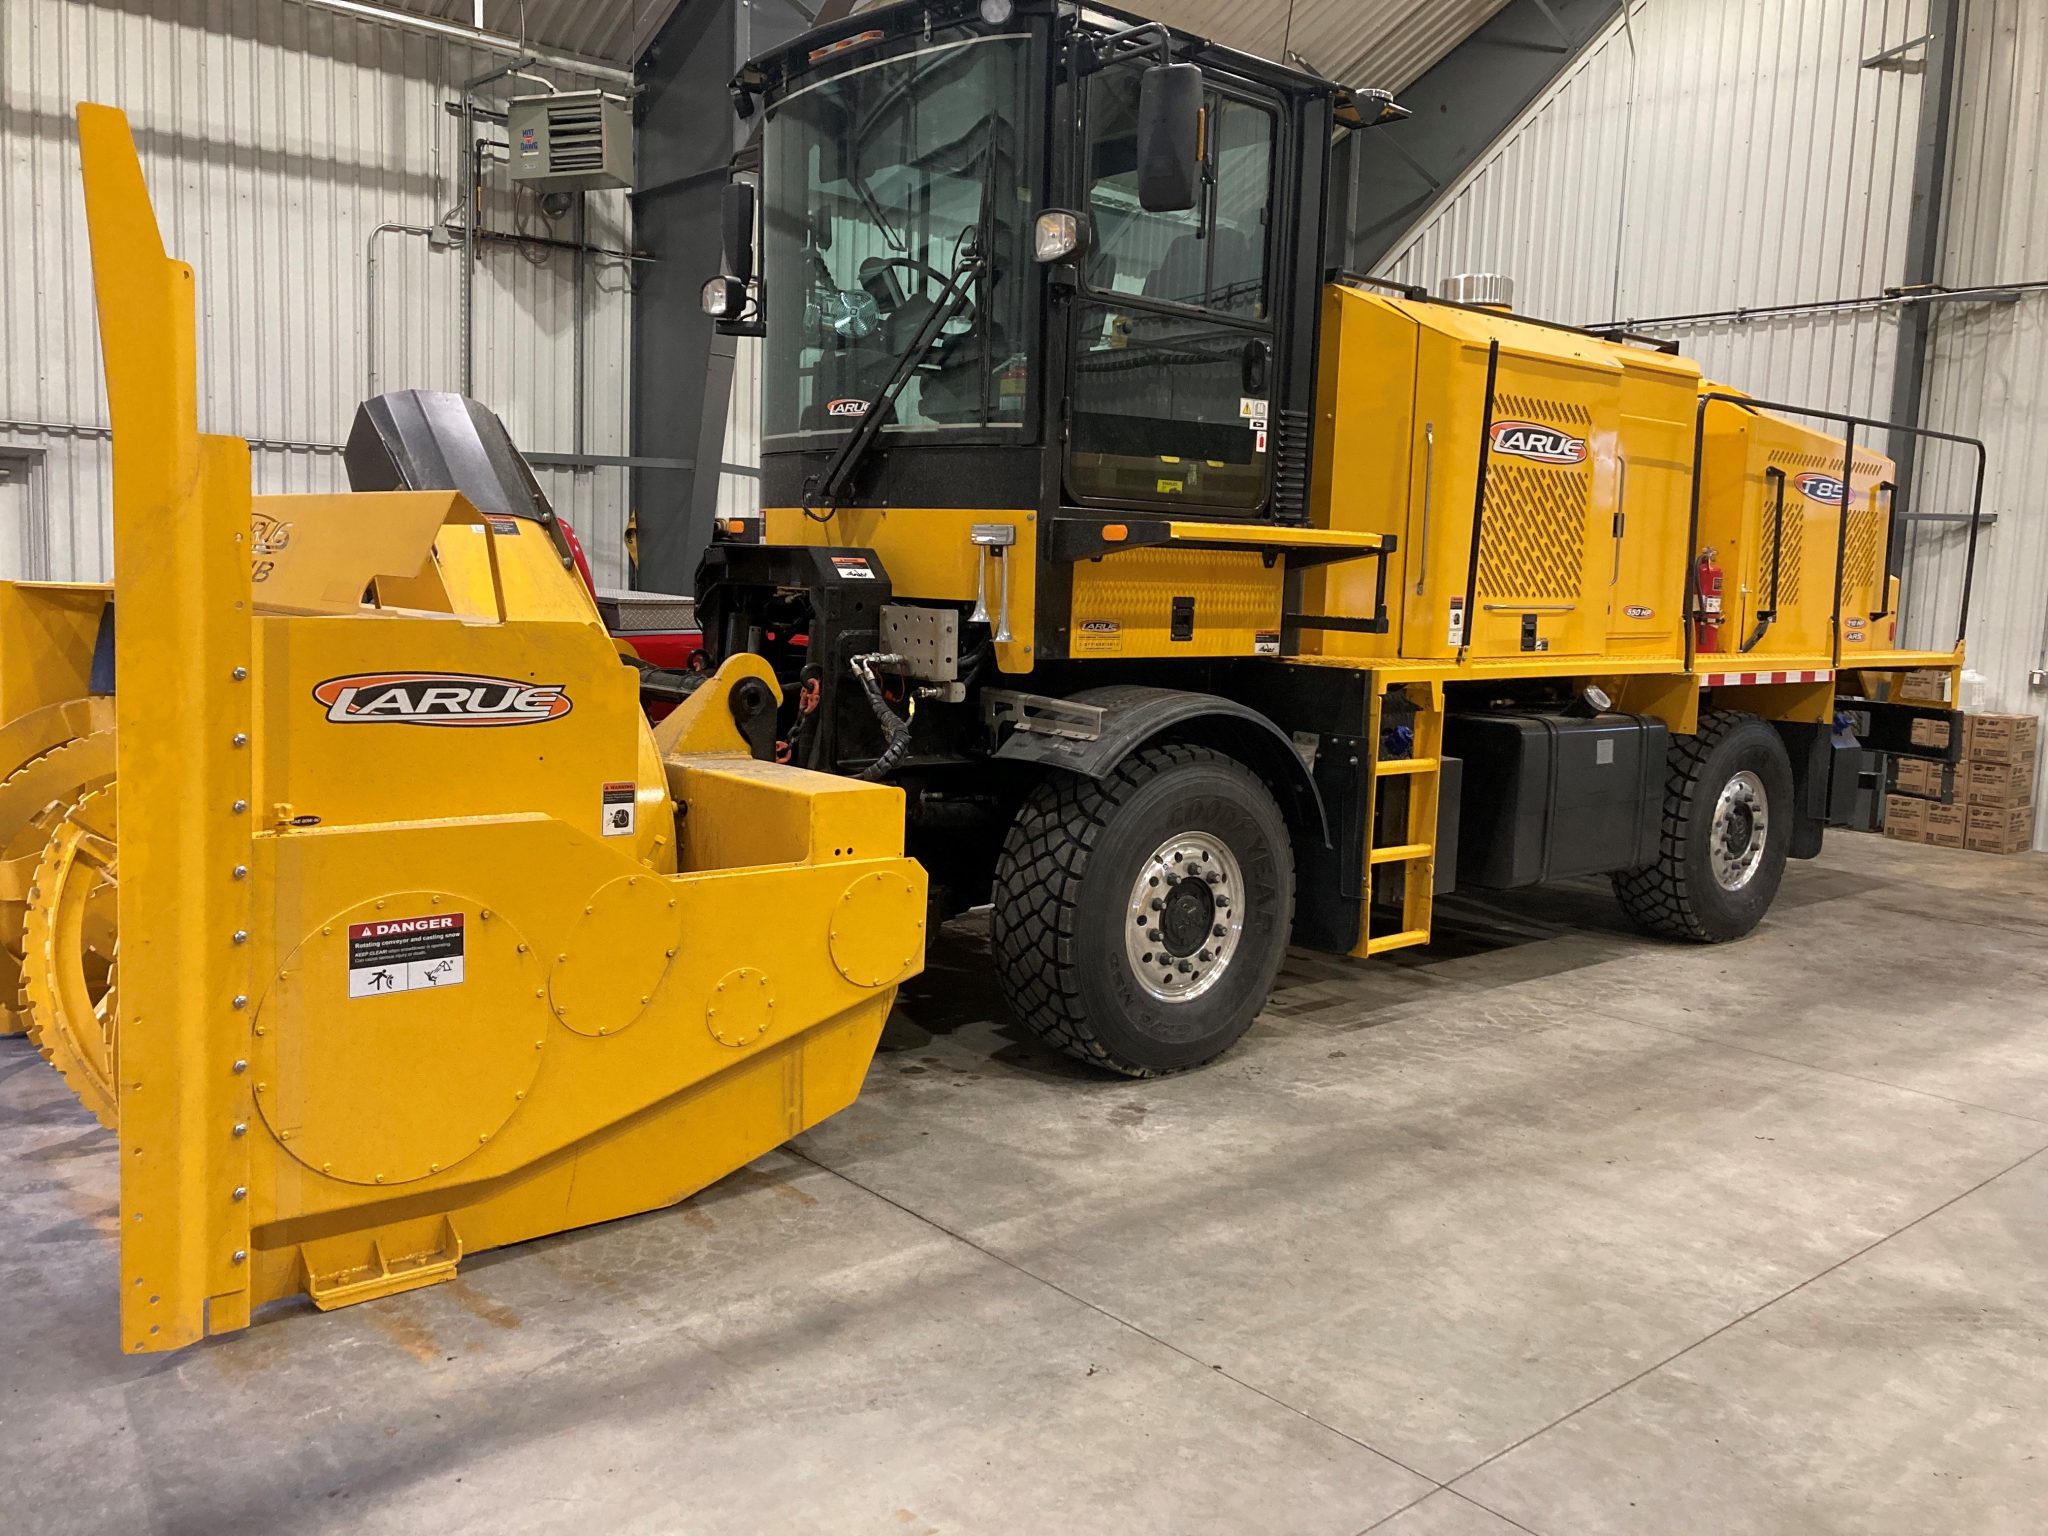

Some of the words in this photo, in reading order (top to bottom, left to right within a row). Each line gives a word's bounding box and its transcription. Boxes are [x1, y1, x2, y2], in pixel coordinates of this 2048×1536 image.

[1492, 428, 1585, 460] LARUE
[1081, 622, 1119, 631] LARUE
[328, 686, 565, 723] LARUE
[376, 917, 453, 935] DANGER
[354, 940, 381, 949] Rotating
[381, 937, 409, 947] conveyor
[422, 934, 444, 942] casting
